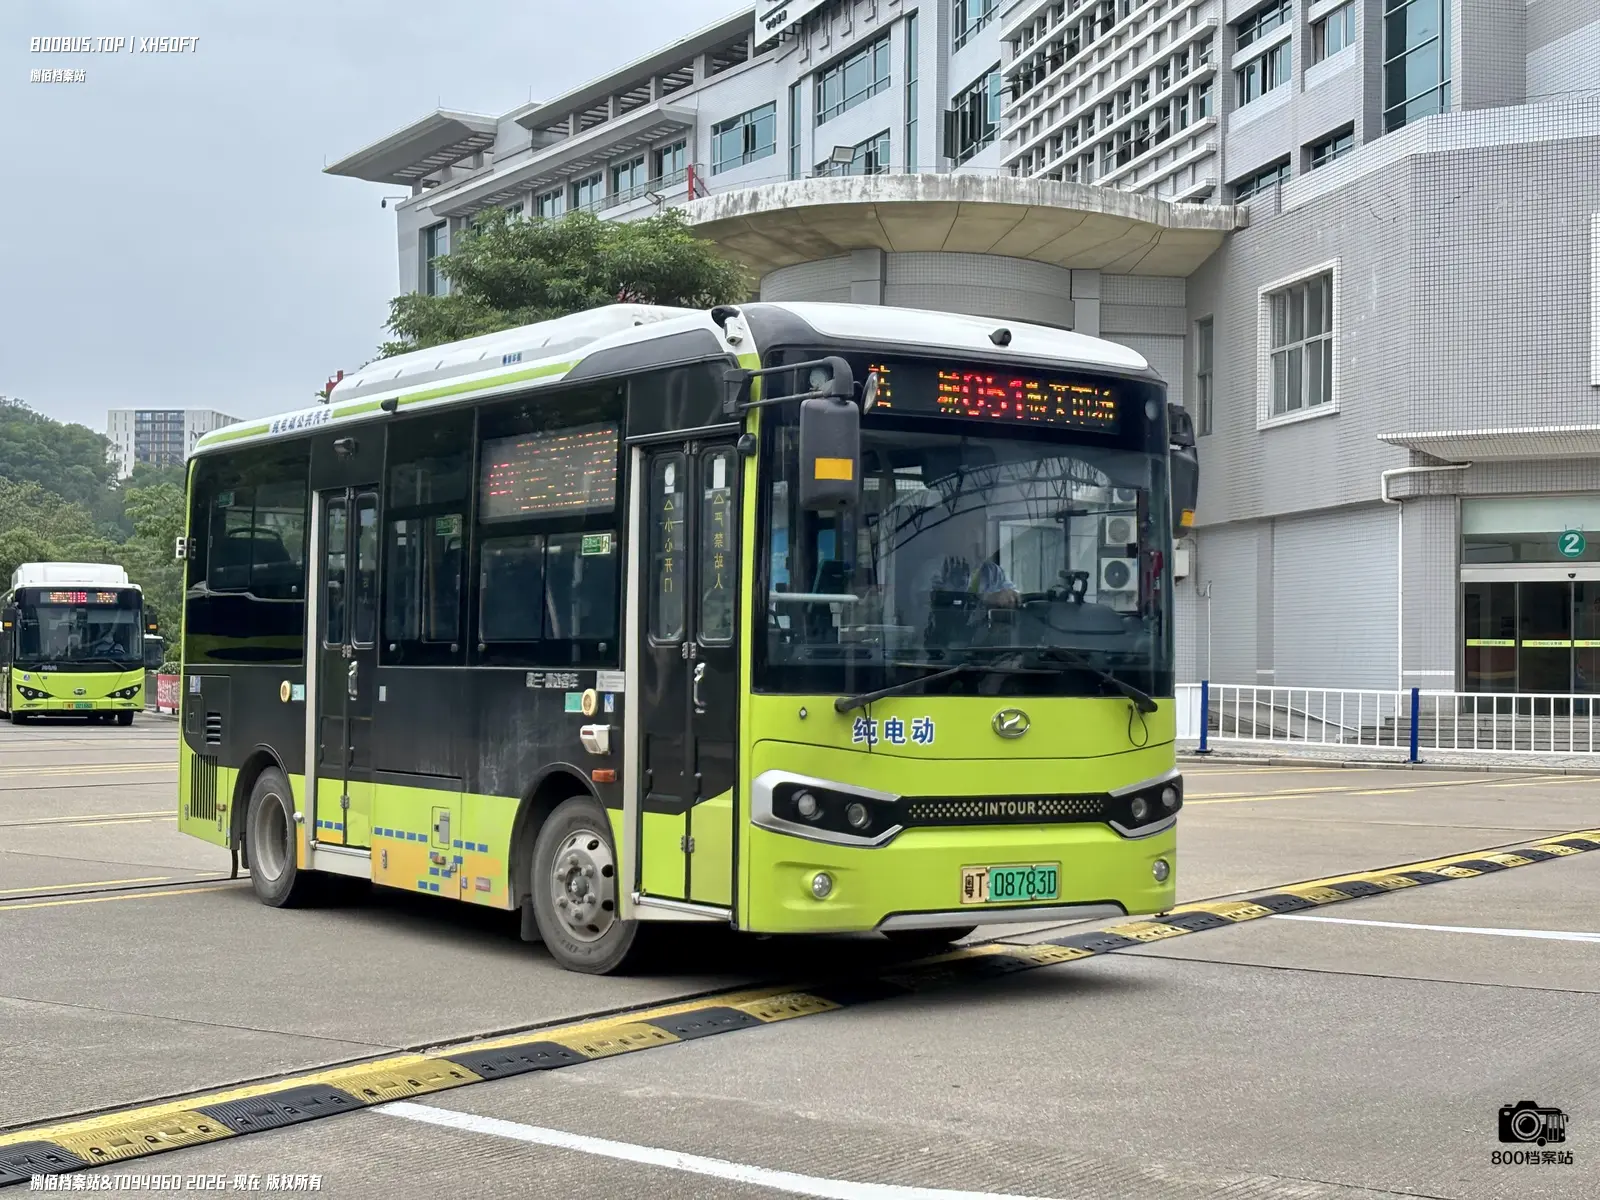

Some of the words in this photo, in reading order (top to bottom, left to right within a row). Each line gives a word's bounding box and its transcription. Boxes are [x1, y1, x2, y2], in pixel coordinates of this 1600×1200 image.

[1564, 533, 1580, 553] 2
[852, 716, 936, 746] 纯电动
[984, 801, 1036, 816] INTOUR
